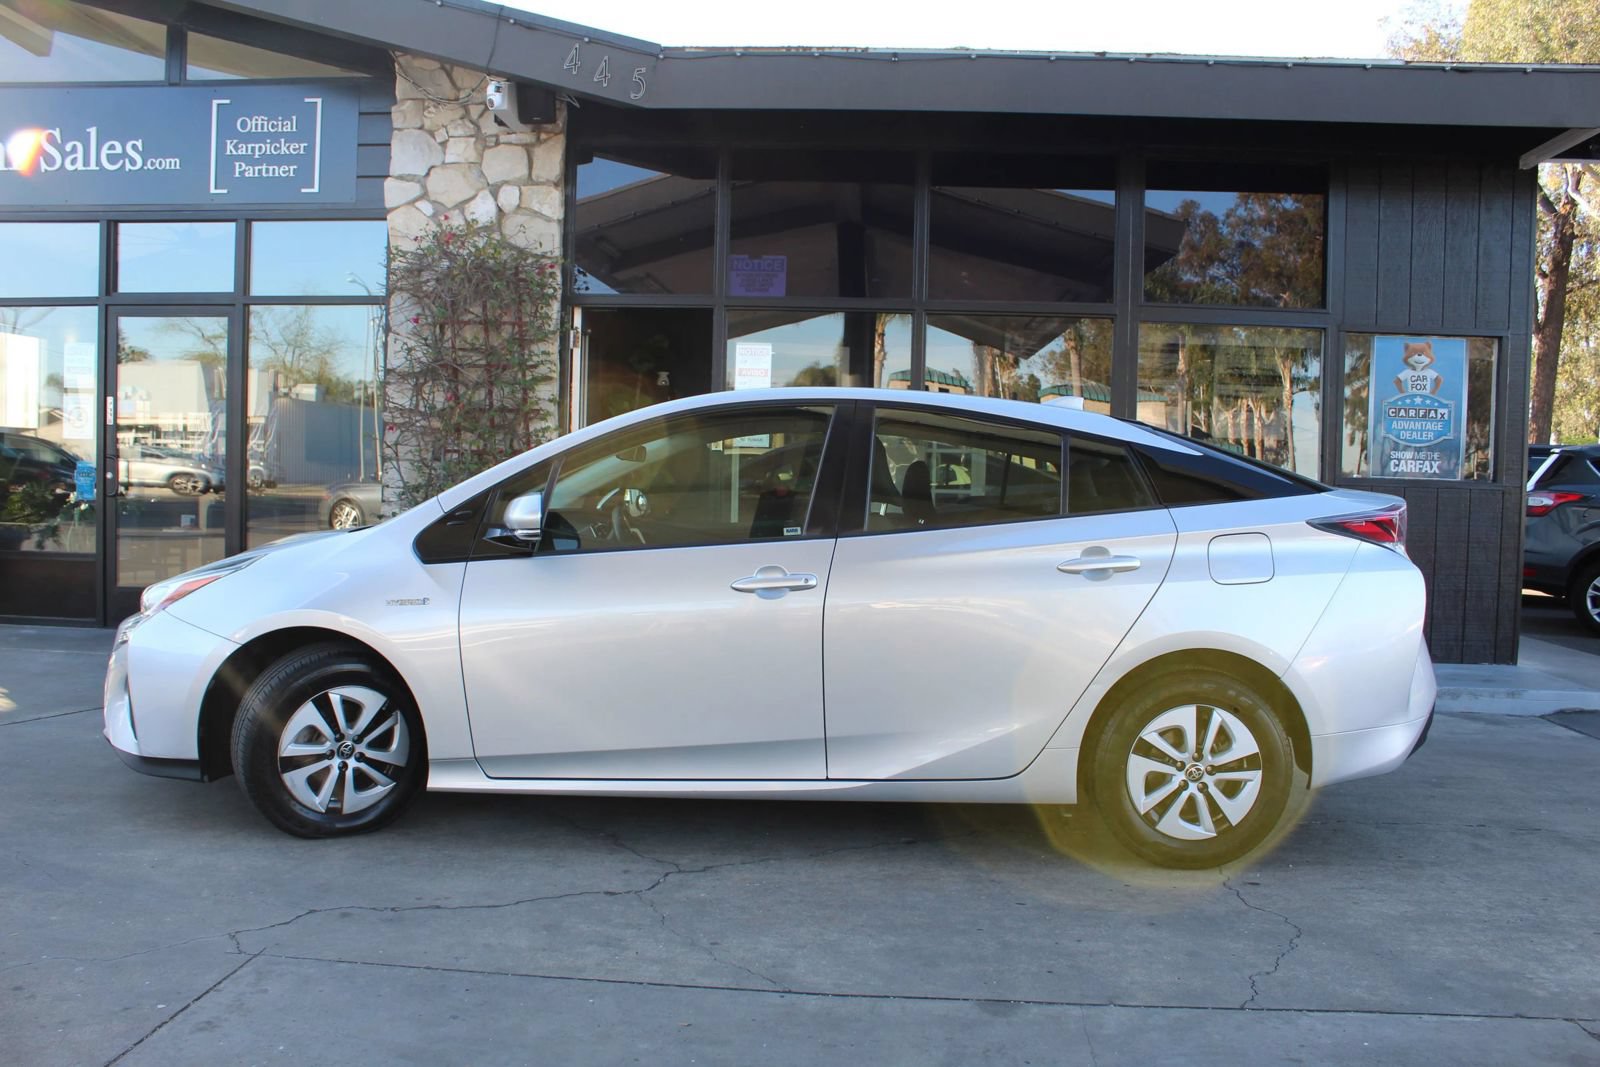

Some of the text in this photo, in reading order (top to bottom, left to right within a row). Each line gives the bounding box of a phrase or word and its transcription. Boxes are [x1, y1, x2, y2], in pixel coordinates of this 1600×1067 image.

[563, 43, 646, 100] 445
[236, 115, 297, 133] Official
[225, 138, 308, 158] Karpicker
[233, 161, 298, 178] Partner
[733, 260, 782, 271] NOTICE
[1410, 375, 1428, 383] CAR
[1410, 383, 1427, 391] FOX
[1388, 408, 1447, 419] CARFAX
[1391, 421, 1443, 431] ADVANTAGE
[1400, 431, 1434, 440] DEALER
[1390, 451, 1440, 460] SHOW ME THE
[1390, 460, 1441, 474] CARFAX
